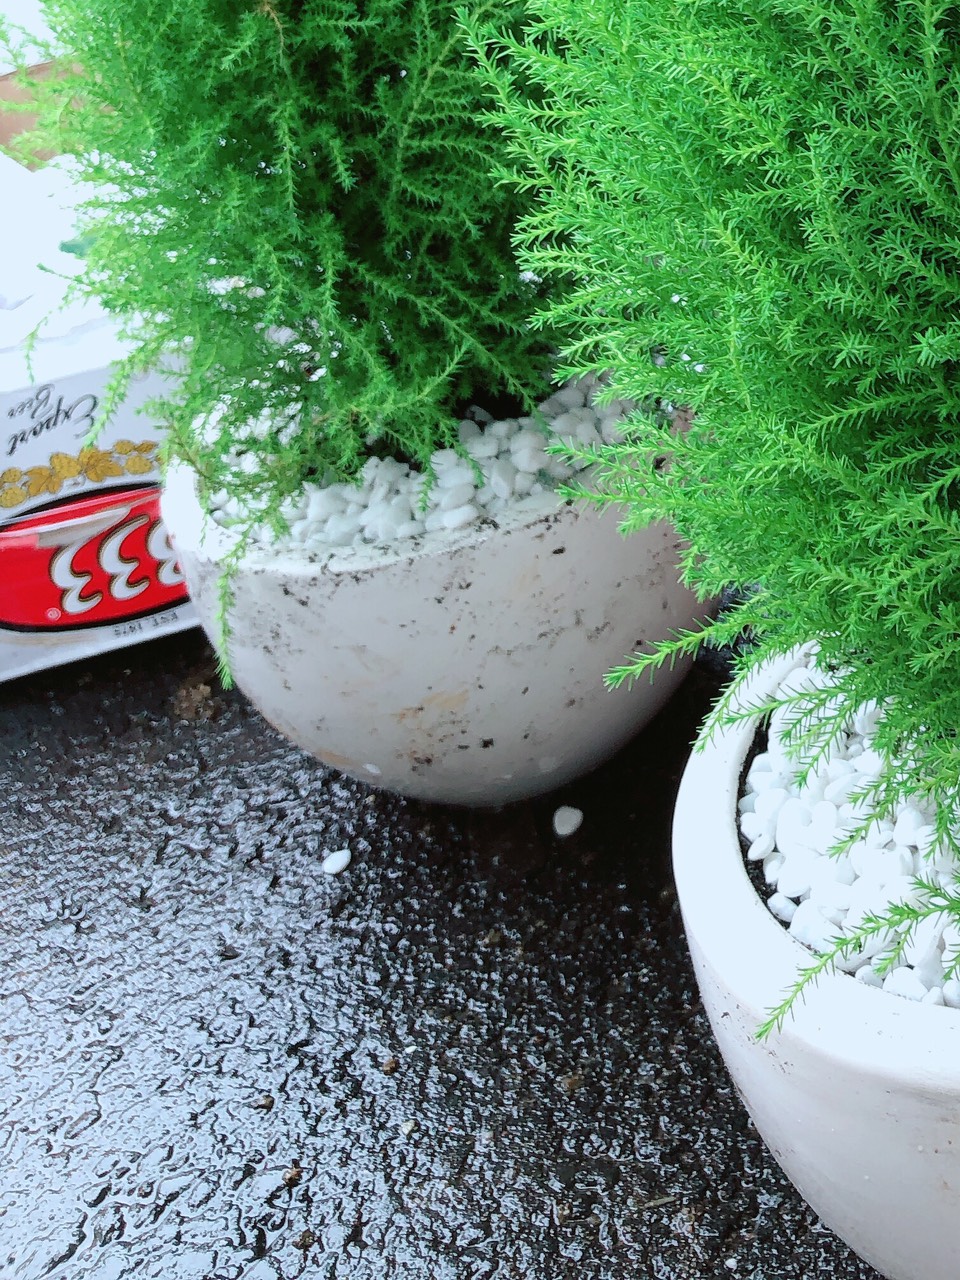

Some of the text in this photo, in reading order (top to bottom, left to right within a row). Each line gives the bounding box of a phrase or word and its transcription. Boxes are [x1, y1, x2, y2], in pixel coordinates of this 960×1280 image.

[6, 393, 99, 456] Export
[7, 383, 55, 419] Beer
[49, 513, 186, 615] 333
